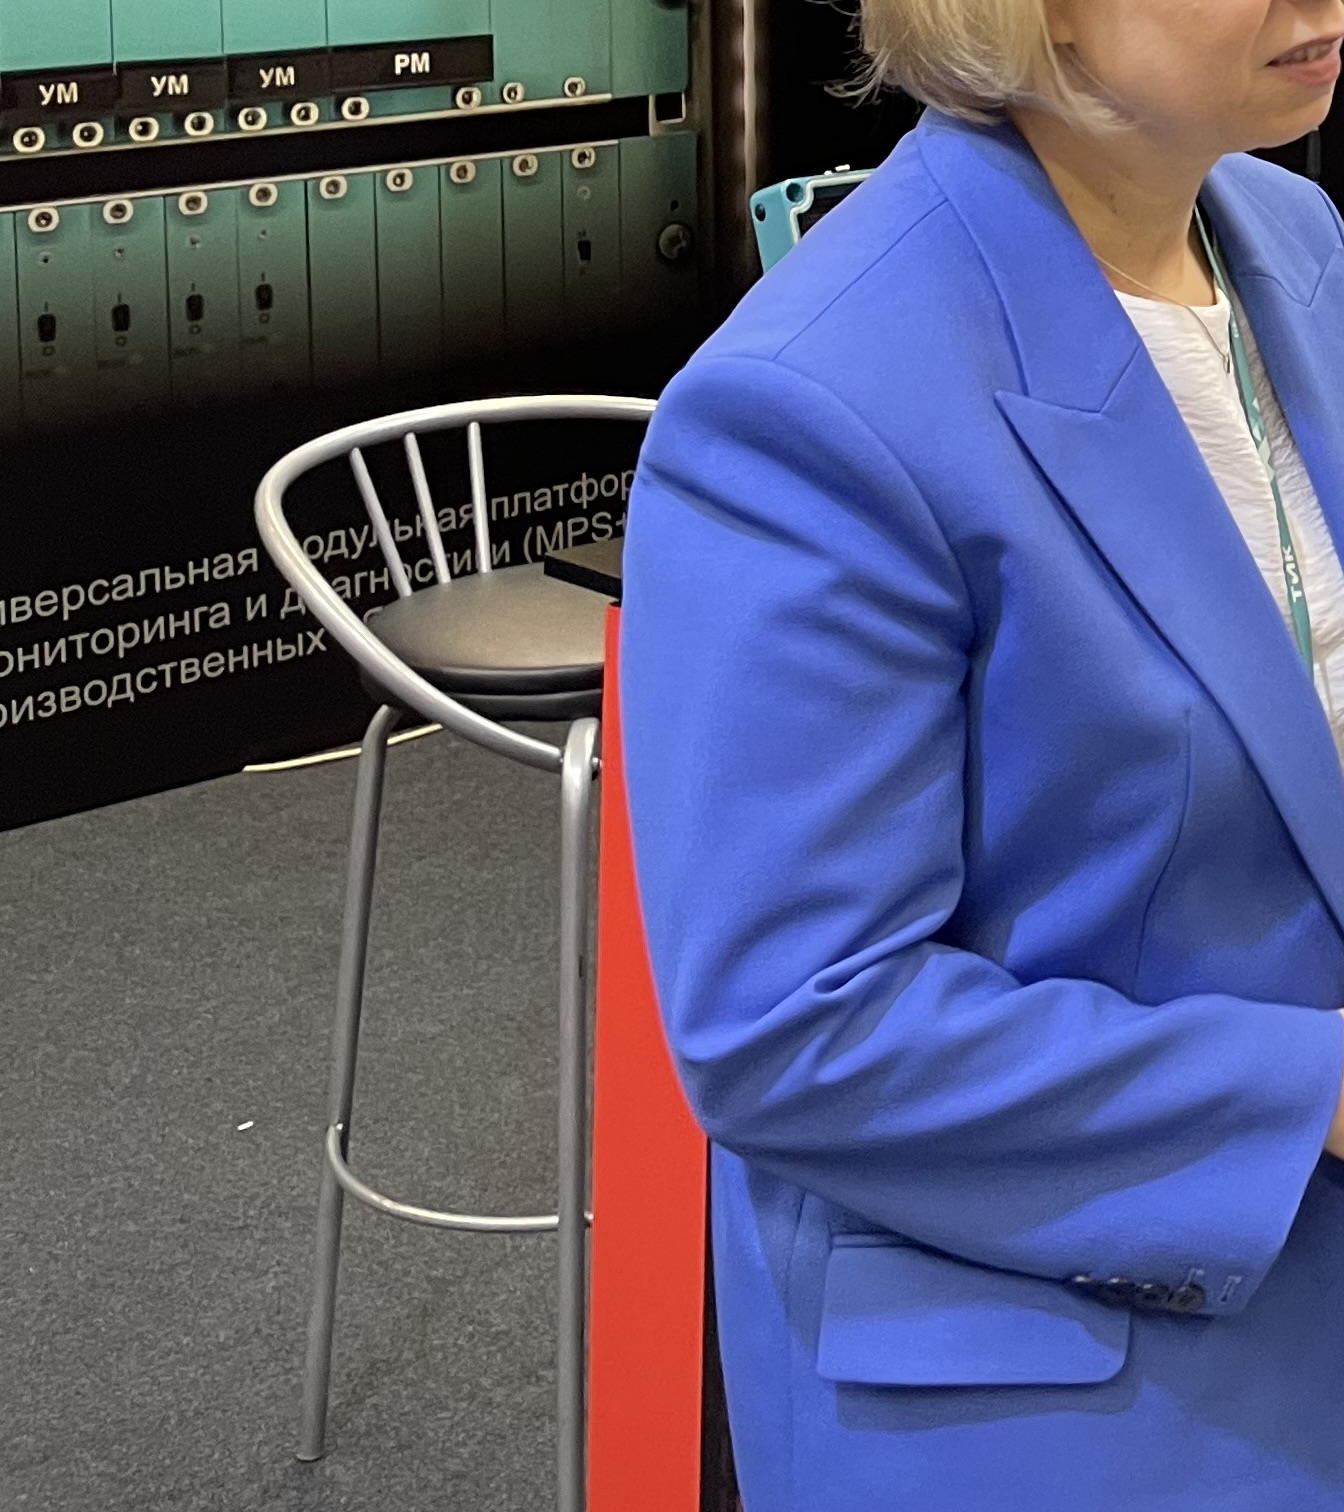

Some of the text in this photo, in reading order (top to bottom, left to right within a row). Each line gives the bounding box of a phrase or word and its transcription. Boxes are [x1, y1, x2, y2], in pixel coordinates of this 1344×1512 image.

[395, 52, 430, 75] РМ
[151, 74, 189, 97] УМ
[260, 66, 295, 88] УМ
[39, 82, 78, 106] УМ
[246, 594, 267, 621] и
